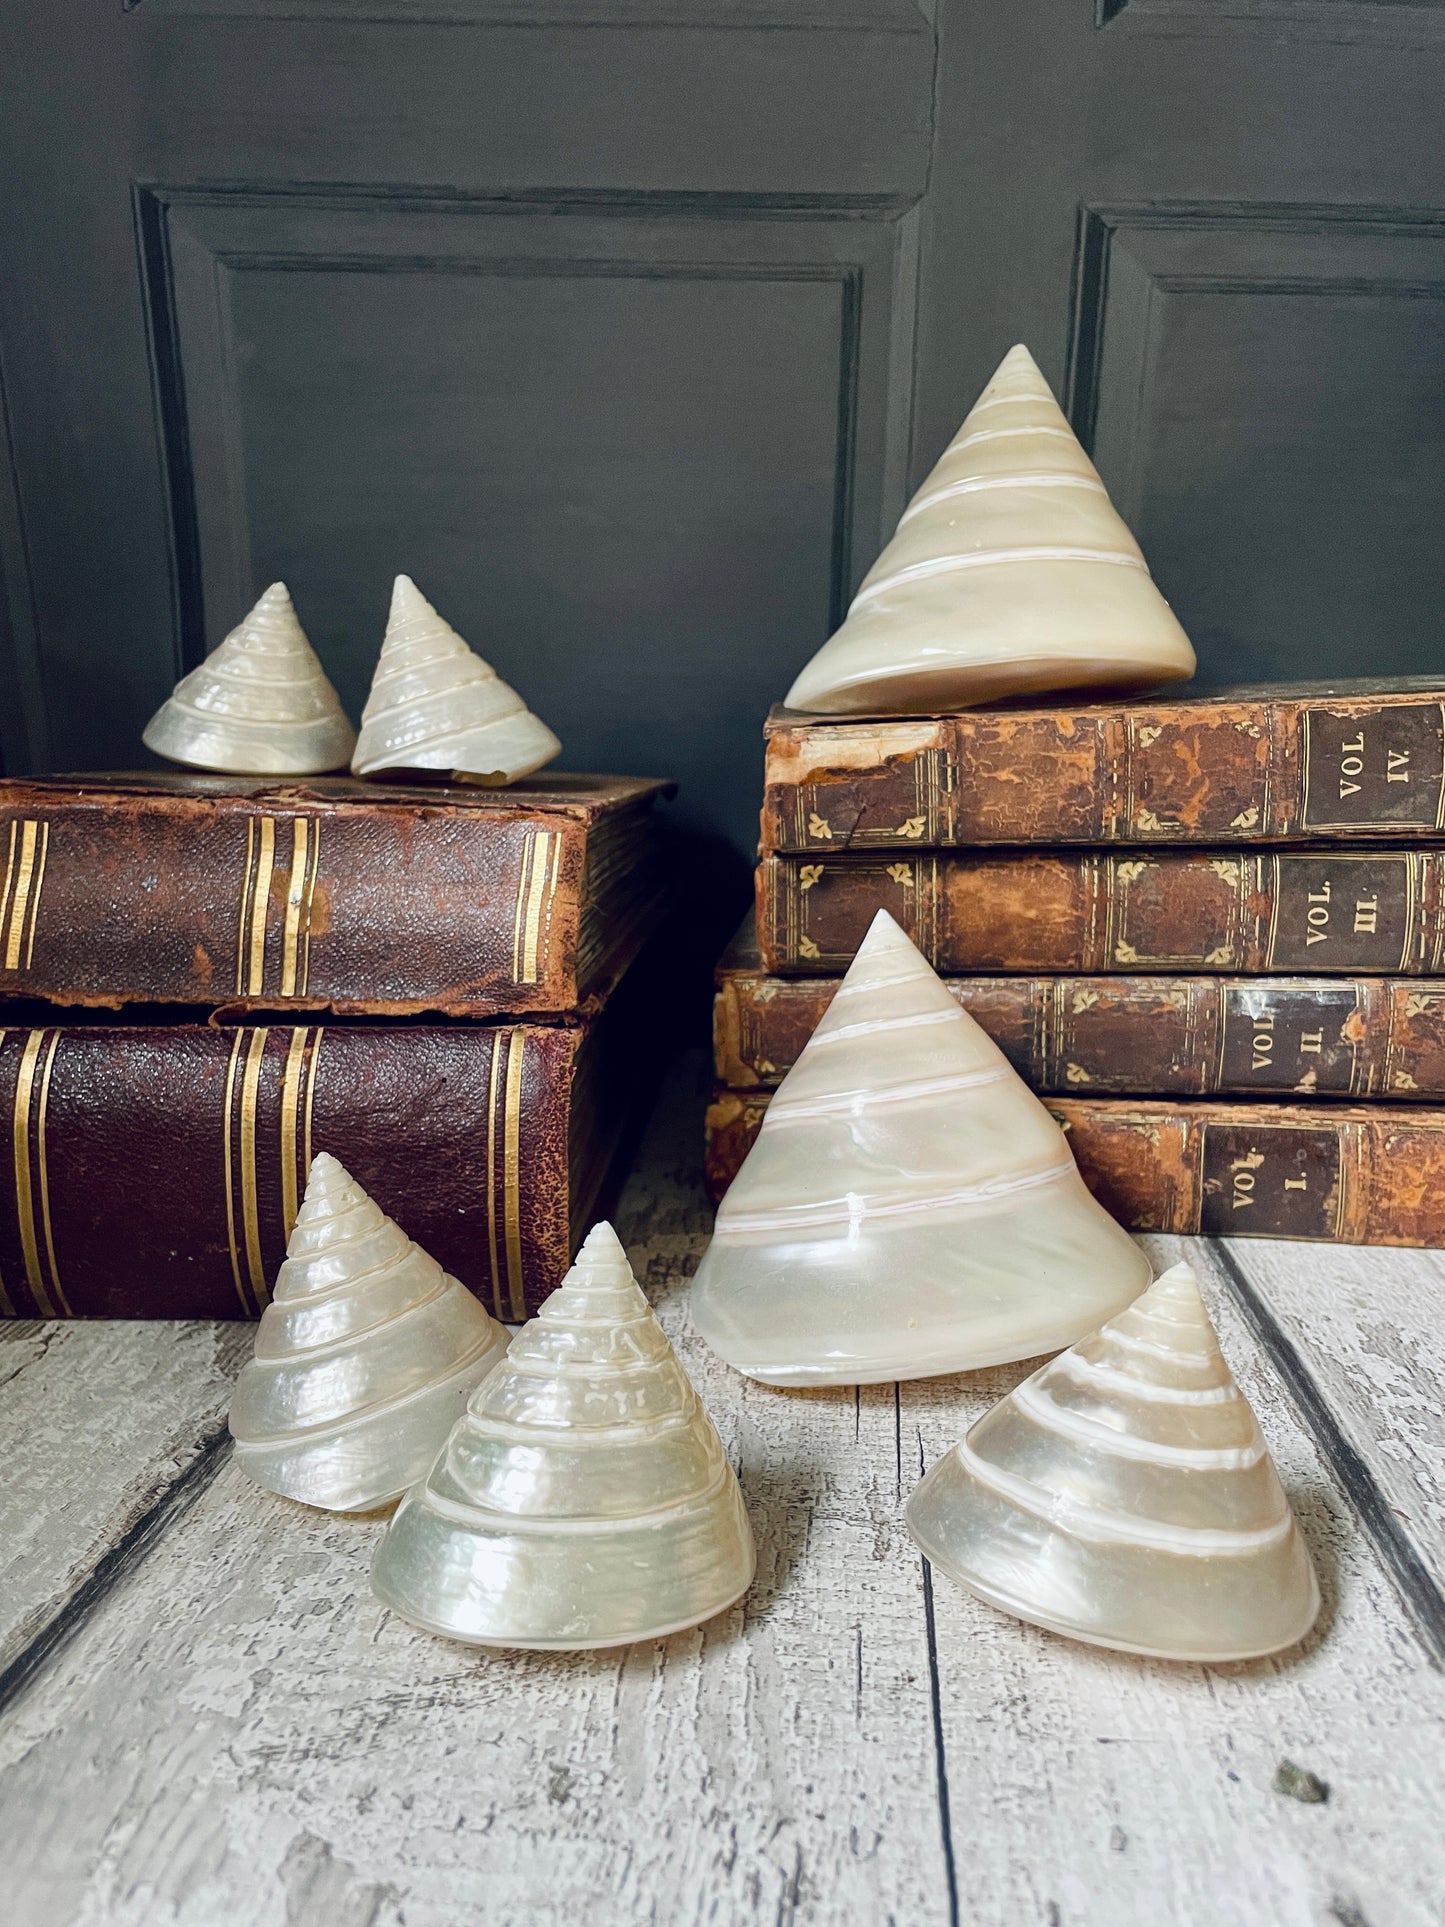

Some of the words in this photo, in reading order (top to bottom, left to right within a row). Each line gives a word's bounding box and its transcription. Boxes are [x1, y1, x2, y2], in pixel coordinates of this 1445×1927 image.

[1387, 750, 1410, 783] IV.
[1306, 880, 1331, 947] VOL.
[1353, 894, 1378, 934] III.
[1300, 1026, 1324, 1054] II.
[1284, 1171, 1307, 1191] I.
